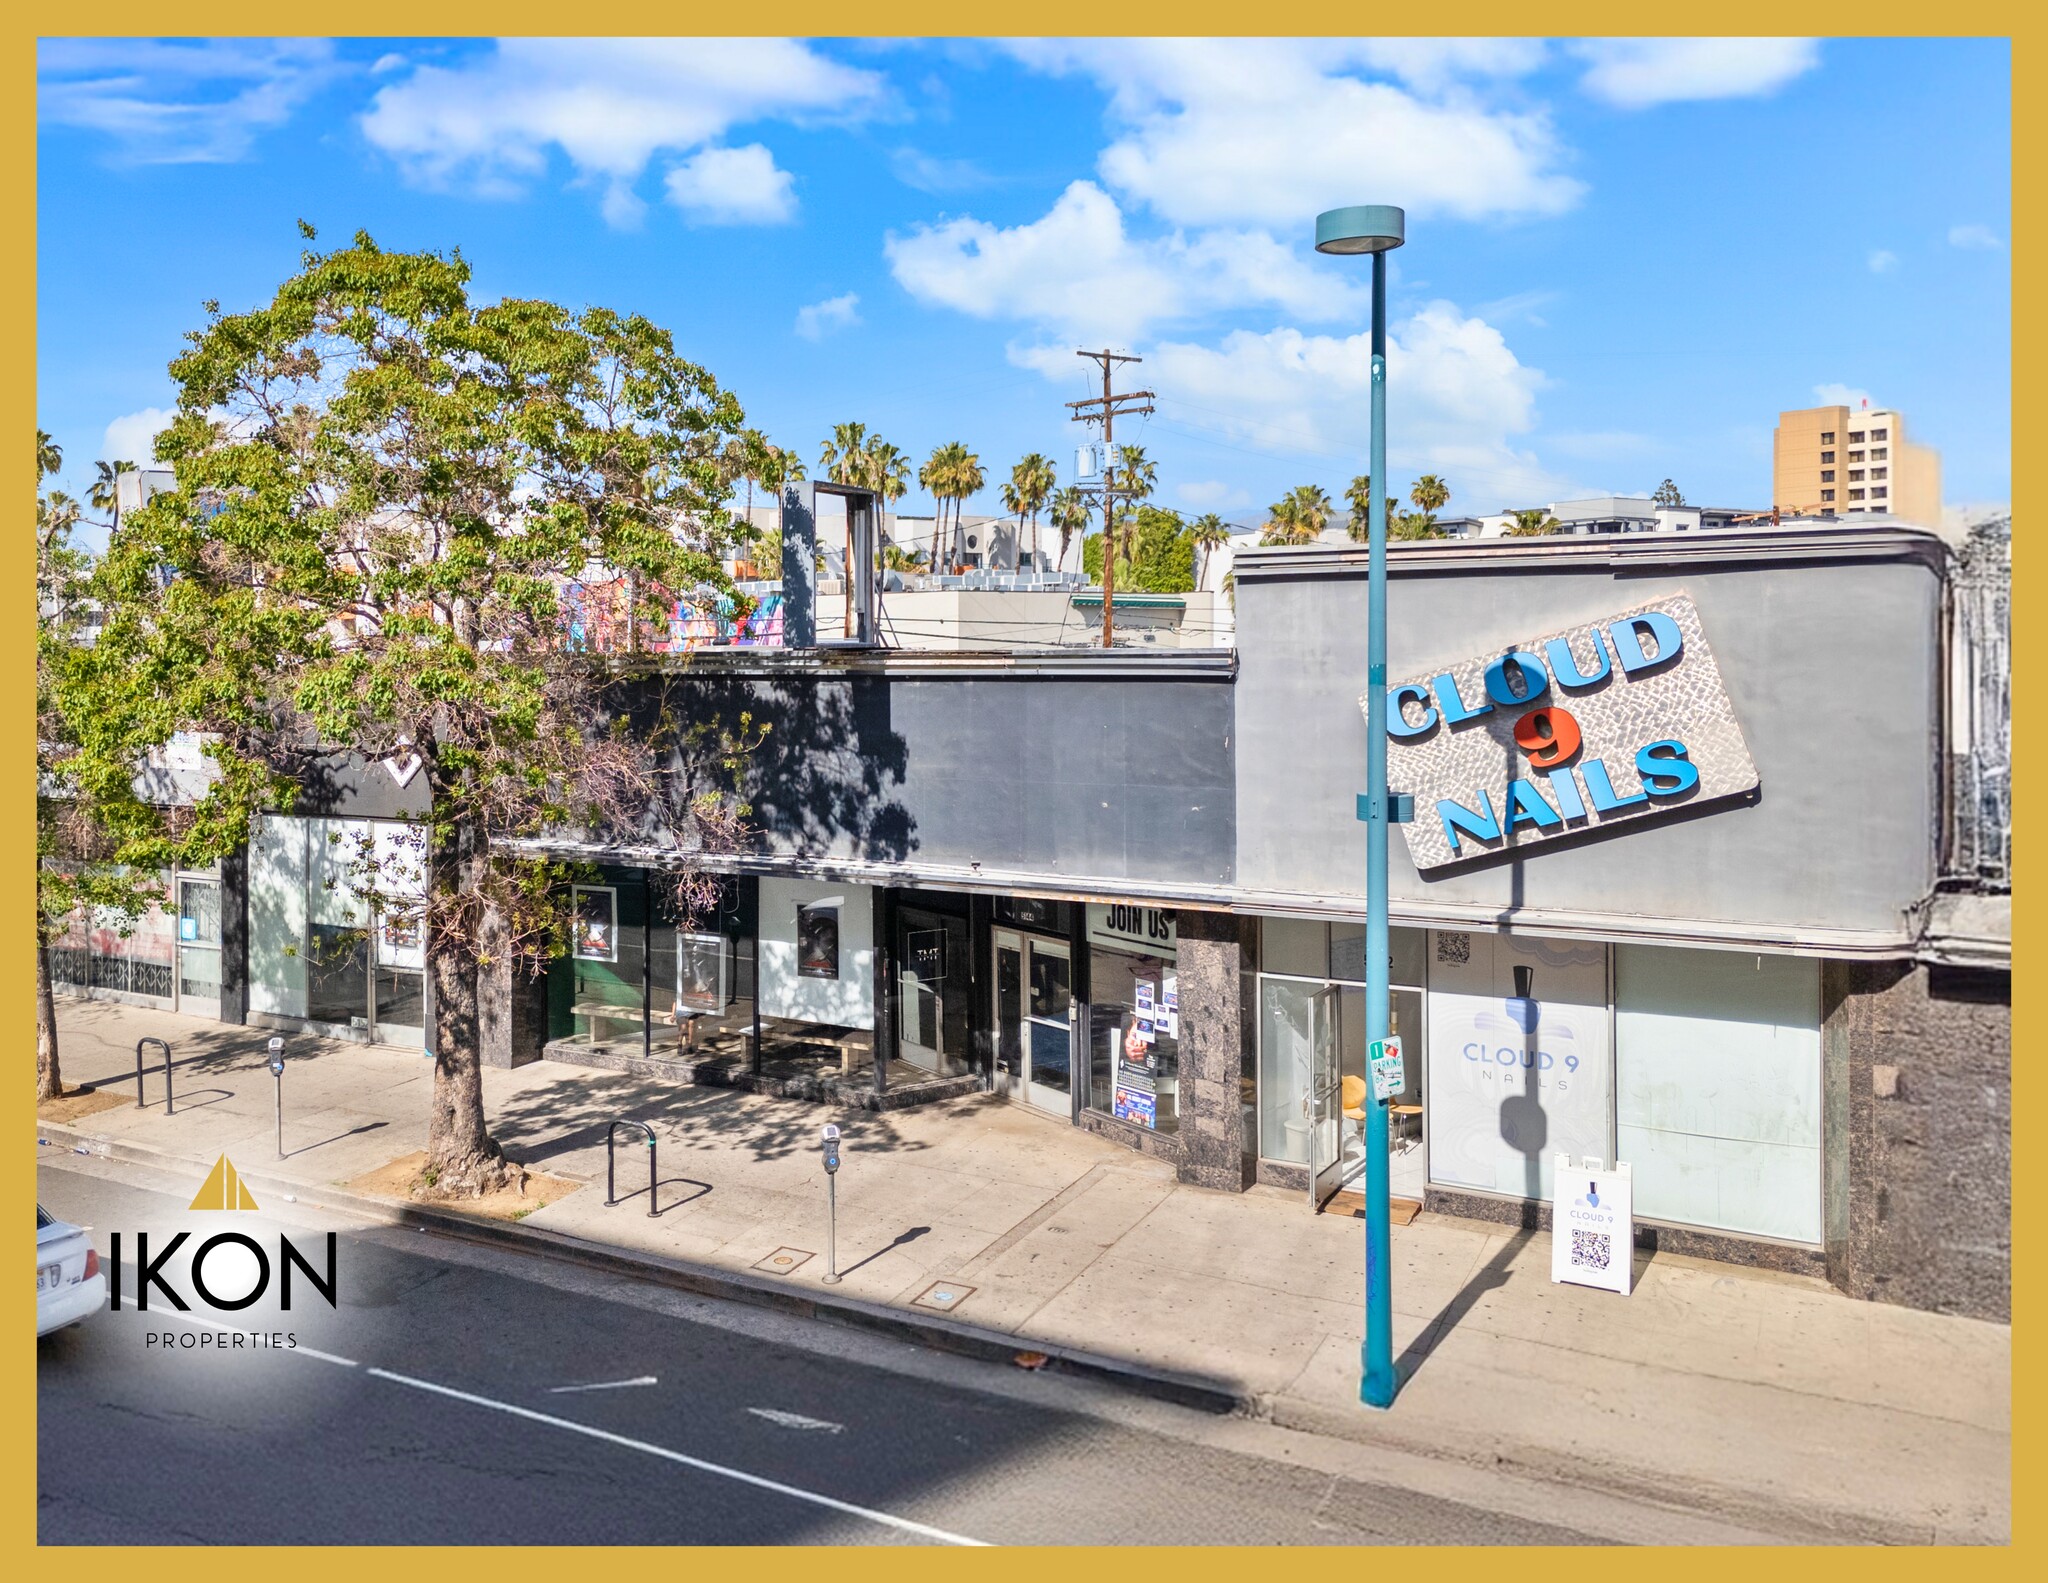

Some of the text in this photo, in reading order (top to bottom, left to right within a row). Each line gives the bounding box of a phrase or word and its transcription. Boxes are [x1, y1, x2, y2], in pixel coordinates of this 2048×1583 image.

[1386, 611, 1683, 737] CLOUD
[1513, 706, 1582, 768] 9
[1436, 739, 1700, 849] NAILS
[1107, 904, 1170, 941] JOIN US
[1373, 1056, 1402, 1070] PARKING
[1463, 1042, 1580, 1073] CLOUD 9
[1482, 1070, 1568, 1090] NAILS
[1570, 1210, 1614, 1224] CLOUD 9
